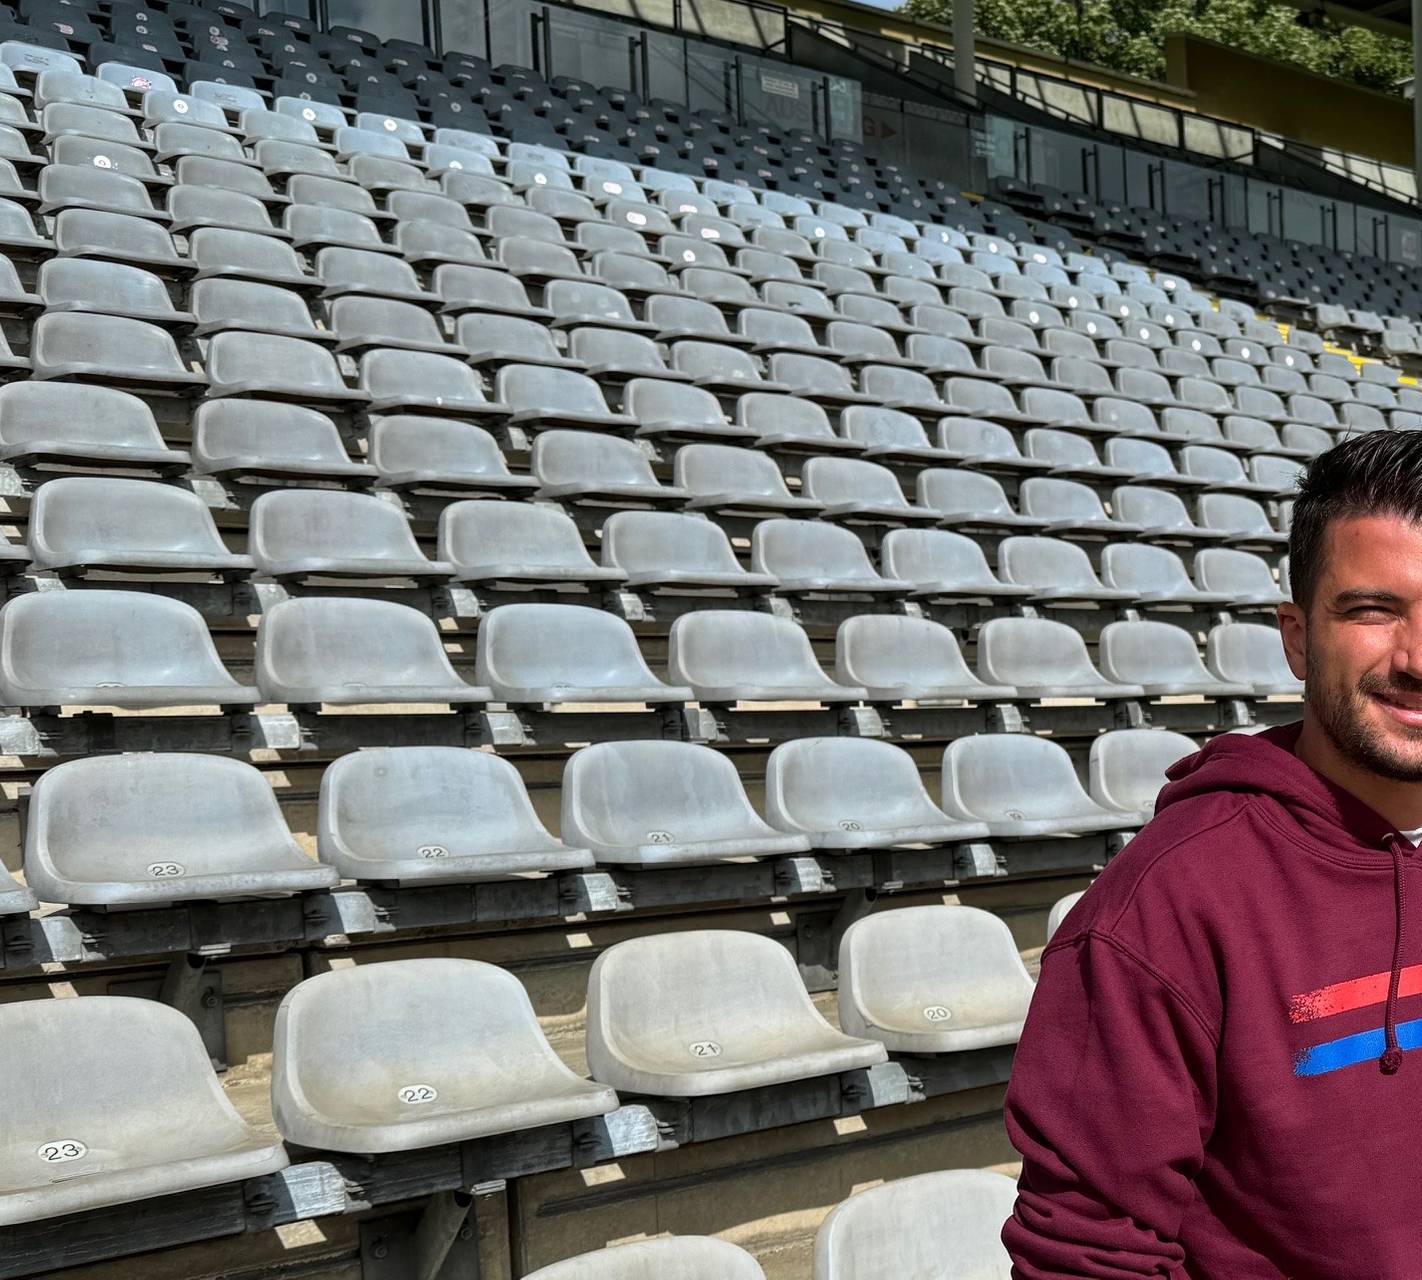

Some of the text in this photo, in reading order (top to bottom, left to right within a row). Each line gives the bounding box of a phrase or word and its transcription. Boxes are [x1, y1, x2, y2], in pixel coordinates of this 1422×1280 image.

[842, 822, 860, 832] 20
[651, 833, 670, 843] 21
[422, 847, 444, 859] 22
[152, 864, 179, 877] 23
[927, 1008, 947, 1020] 20
[694, 1043, 717, 1056] 21
[403, 1087, 433, 1103] 22
[45, 1143, 79, 1161] 23
